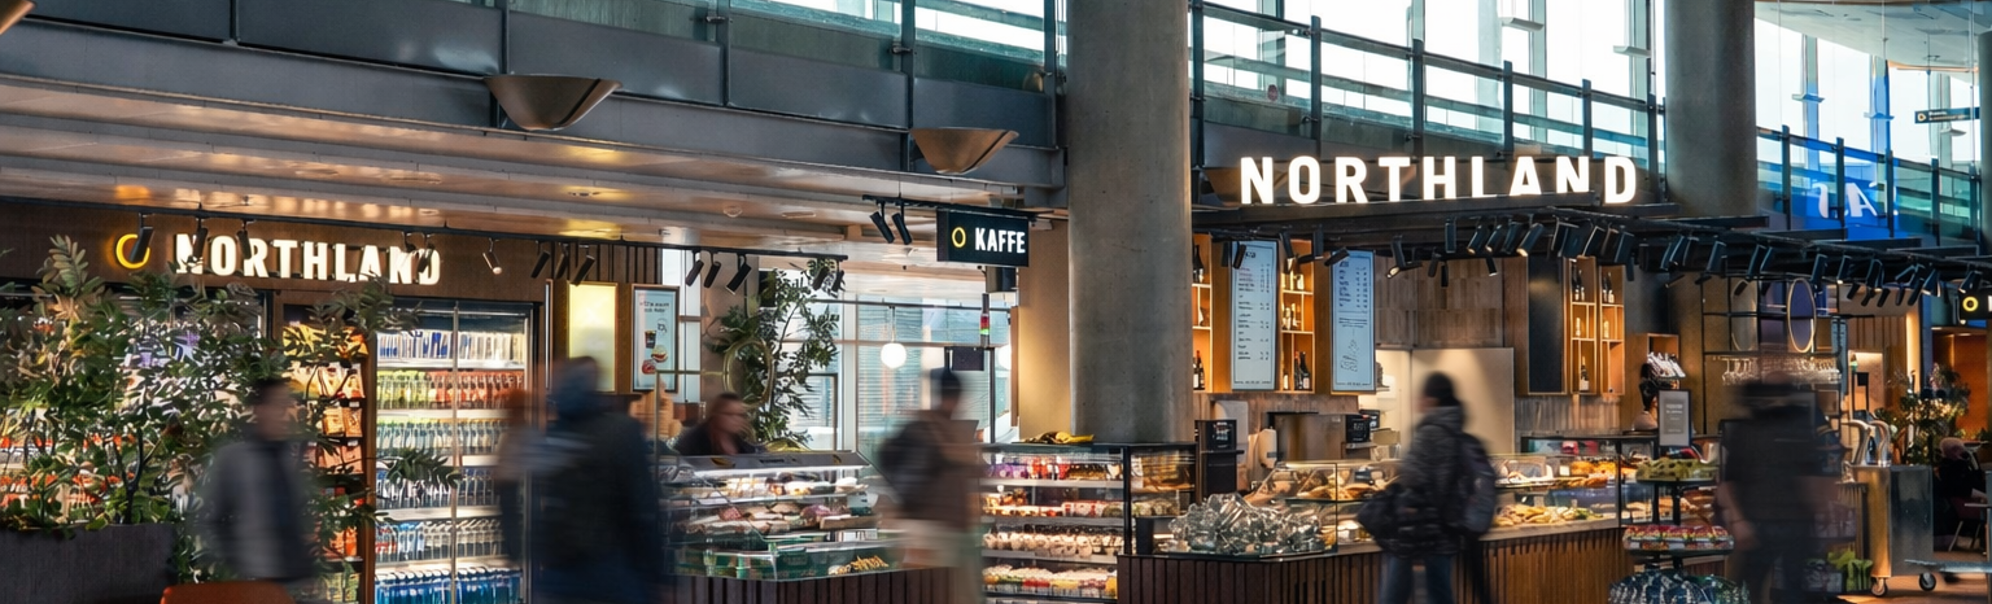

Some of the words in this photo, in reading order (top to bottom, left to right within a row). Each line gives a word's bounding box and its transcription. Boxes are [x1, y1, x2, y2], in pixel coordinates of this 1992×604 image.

[1240, 156, 1637, 205] NORTHLAND
[176, 233, 441, 285] NORTHLAND
[975, 227, 1026, 254] KAFFE
